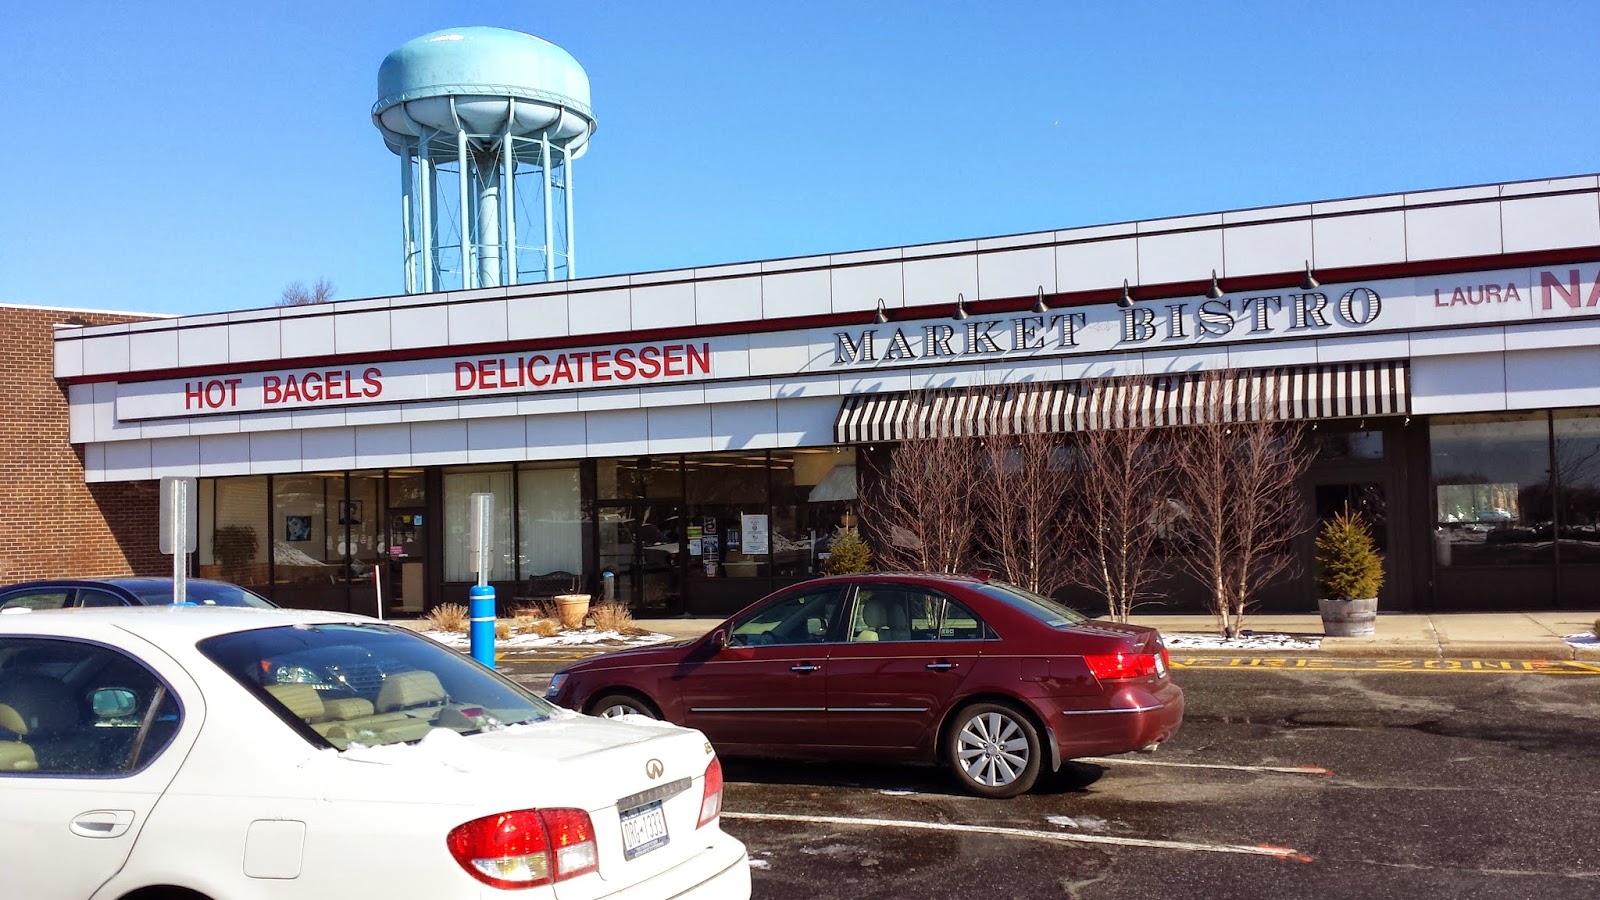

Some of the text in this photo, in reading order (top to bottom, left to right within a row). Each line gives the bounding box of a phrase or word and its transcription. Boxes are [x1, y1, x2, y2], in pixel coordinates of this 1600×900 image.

[1434, 283, 1521, 307] LAURA
[833, 287, 1382, 363] MARKET BISTRO
[186, 368, 382, 410] HOT BAGELS
[455, 343, 710, 392] DELICATESSEN
